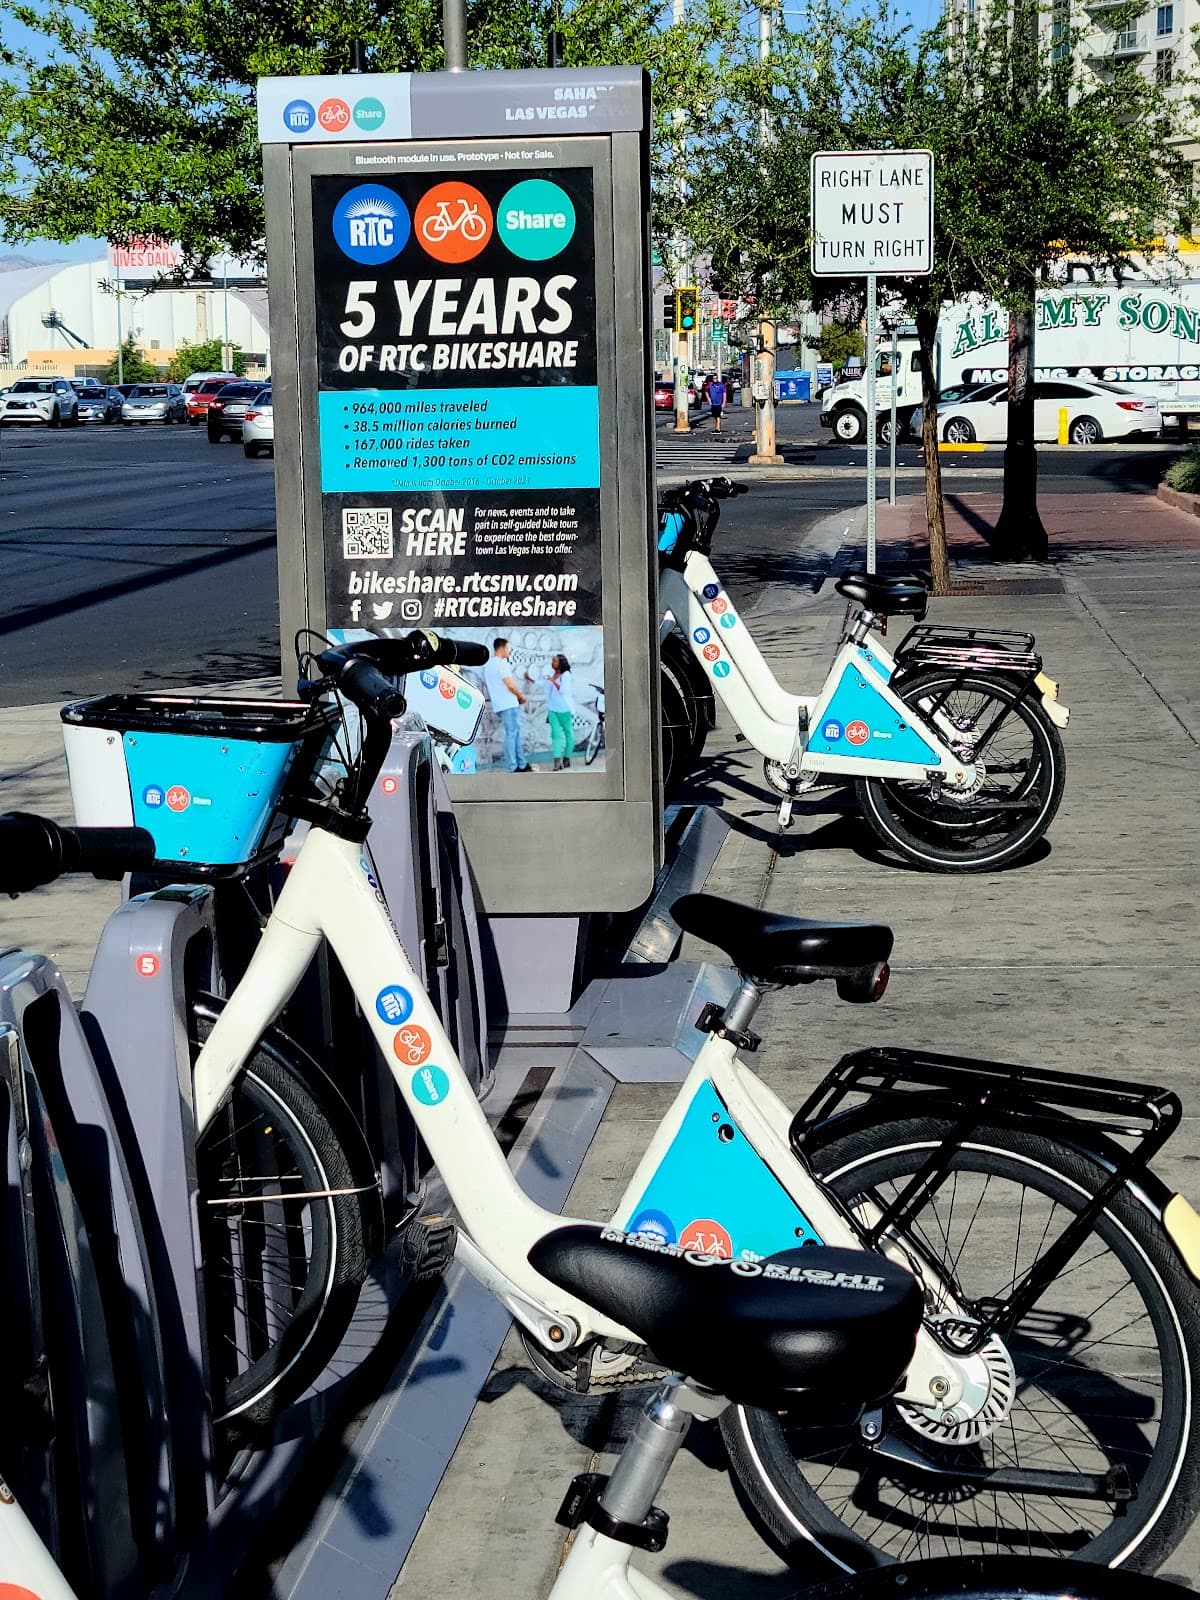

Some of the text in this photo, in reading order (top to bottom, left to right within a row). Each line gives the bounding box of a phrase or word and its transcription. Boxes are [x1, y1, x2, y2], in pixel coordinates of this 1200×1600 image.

[554, 86, 615, 101] SAHA
[289, 113, 309, 127] RTC
[356, 109, 382, 119] Share
[505, 107, 535, 121] LAS
[536, 105, 588, 119] VEGAS
[355, 150, 554, 165] Bluetooth module in use. Prototype Not for Sale.
[821, 168, 924, 188] RIGHT LANE
[506, 209, 567, 230] Share
[842, 202, 904, 225] MUST
[350, 217, 394, 247] RTC
[820, 239, 924, 258] TURN RIGHT
[113, 251, 179, 267] LIVES DAILY
[339, 274, 578, 339] 5 YEARS
[951, 310, 1009, 358] AL
[1037, 294, 1110, 330] MY
[338, 341, 579, 373] OF RTC BIKESHARE
[970, 367, 1200, 384] MONG & STORAG
[352, 400, 488, 415] 964,000 miles traveled
[352, 417, 518, 432] 38.5 million calories burned
[353, 438, 470, 451] 167,000 rides taken
[353, 454, 577, 469] Removed 1,300 tons of CO2 emissions
[400, 508, 465, 533] SCAN
[474, 506, 576, 518] For news, events and to take
[474, 518, 579, 532] part in self-guided bike tours
[405, 531, 468, 556] HERE
[475, 531, 579, 544] to experience the best down-
[475, 543, 573, 557] town Las Vegas has to offer.
[348, 570, 579, 595] bikeshare.rtcsnv.com
[432, 595, 578, 618] #RTCBikeShare
[384, 779, 395, 791] 9
[141, 957, 154, 973] 5
[380, 992, 401, 1021] RTC
[420, 1067, 440, 1101] Share
[600, 1230, 624, 1244] FOR
[625, 1237, 685, 1258] COMFORT
[762, 1271, 805, 1283] ADJUST
[807, 1278, 839, 1288] YOUR
[763, 1263, 886, 1287] RIGHT
